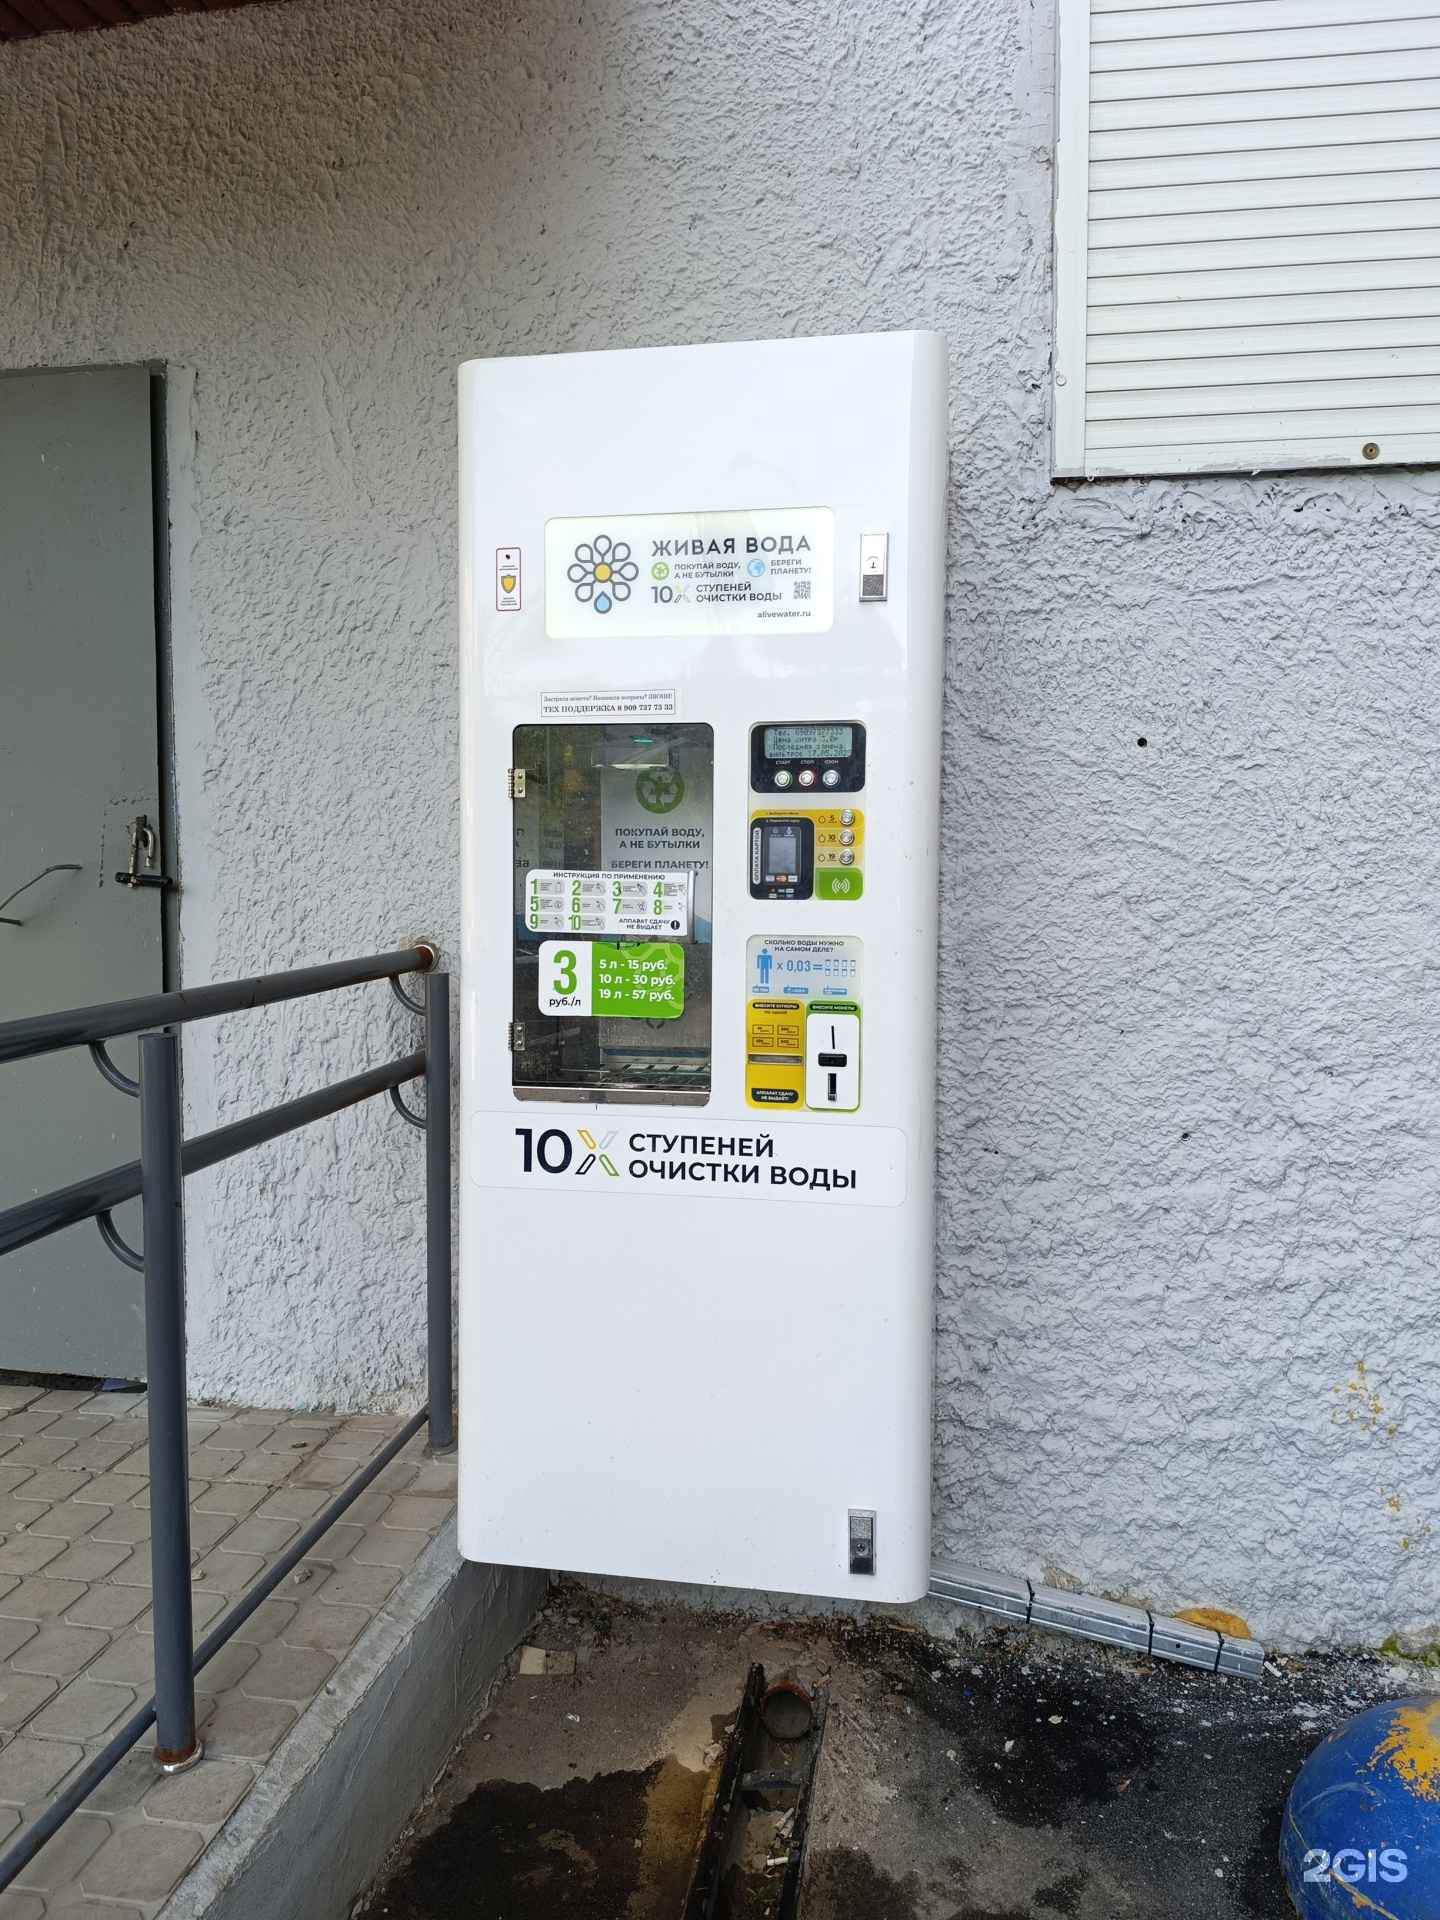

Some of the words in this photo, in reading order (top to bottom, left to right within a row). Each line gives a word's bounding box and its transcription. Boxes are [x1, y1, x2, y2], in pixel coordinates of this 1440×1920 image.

[651, 538, 735, 556] ЖИВАЯ
[746, 535, 811, 555] ВОДА
[674, 561, 714, 571] ПОКУПАЙ
[770, 559, 802, 567] БЕРЕГИ
[696, 581, 752, 593] СТУПЕНЕЙ
[696, 593, 746, 603] ОЧИСТКИ
[749, 592, 782, 602] ВОДЫ
[757, 610, 811, 619] alivewater.ru
[544, 705, 559, 713] ТЕХ
[561, 704, 616, 713] ПОДДЕРЖКА
[615, 826, 669, 837] ПОКУПАЙ
[671, 828, 705, 838] ВОДУ,
[647, 840, 700, 849] БУТЫЛКИ
[611, 861, 652, 869] БЕРЕГИ
[654, 860, 709, 870] ПЛАНЕТУ!
[553, 872, 600, 880] ИНСТРУКЦИЯ
[614, 873, 666, 881] ПРИМЕНЕНИЮ
[531, 879, 538, 895] 1
[572, 880, 581, 896] 2
[612, 881, 622, 897] 3
[653, 882, 663, 897] 4
[530, 896, 539, 912] 5
[572, 897, 581, 913] 6
[612, 898, 622, 914] 7
[653, 900, 662, 915] 8
[530, 914, 538, 929] 9
[568, 915, 581, 930] 10
[553, 949, 577, 995] 3
[599, 960, 606, 969] 5
[608, 961, 617, 969] л
[628, 960, 640, 969] 15
[642, 960, 668, 971] руб.
[786, 960, 811, 972] 0,03
[599, 974, 612, 983] 10
[614, 976, 623, 984] л
[632, 975, 648, 984] 30
[650, 975, 676, 987] руб.
[549, 996, 581, 1007] руб./л
[599, 989, 611, 998] 19
[613, 991, 623, 999] л
[632, 990, 646, 999] 57
[649, 990, 675, 1001] руб.
[629, 1133, 774, 1157] СТУПЕНЕЙ
[628, 1159, 759, 1184] ОЧИСТКИ
[769, 1165, 856, 1191] ВОДЫ
